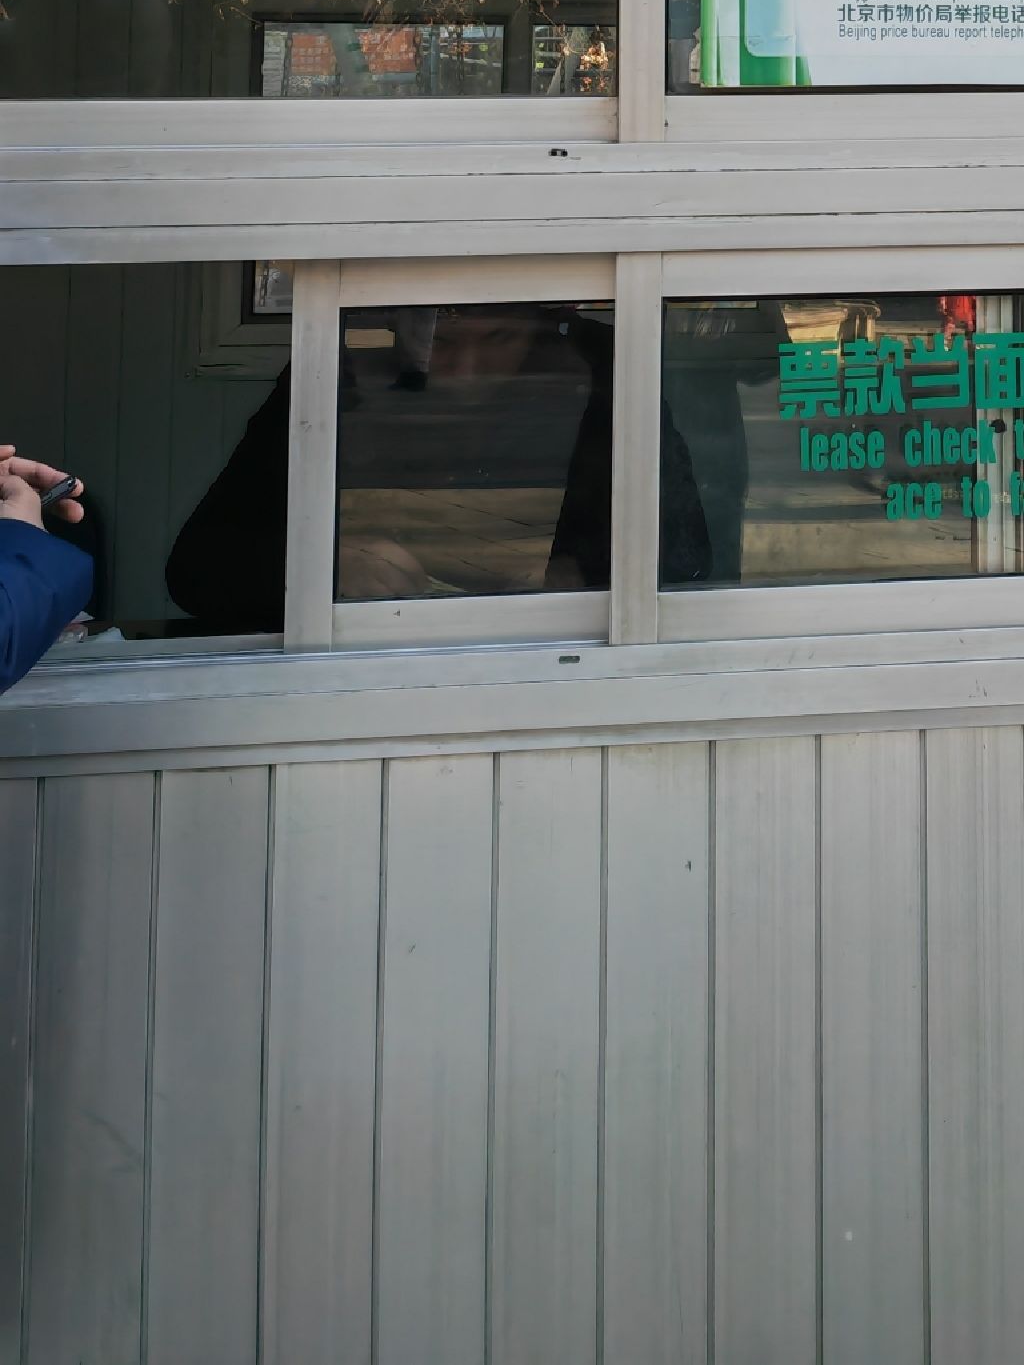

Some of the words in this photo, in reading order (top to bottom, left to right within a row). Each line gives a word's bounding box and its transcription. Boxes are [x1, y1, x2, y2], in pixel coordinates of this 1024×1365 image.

[839, 25, 876, 41] Beijing
[880, 26, 908, 40] price
[911, 26, 949, 38] bureau
[954, 26, 987, 40] report
[799, 427, 885, 471] lease
[904, 420, 996, 467] check
[886, 480, 942, 520] ace
[960, 475, 990, 517] to
